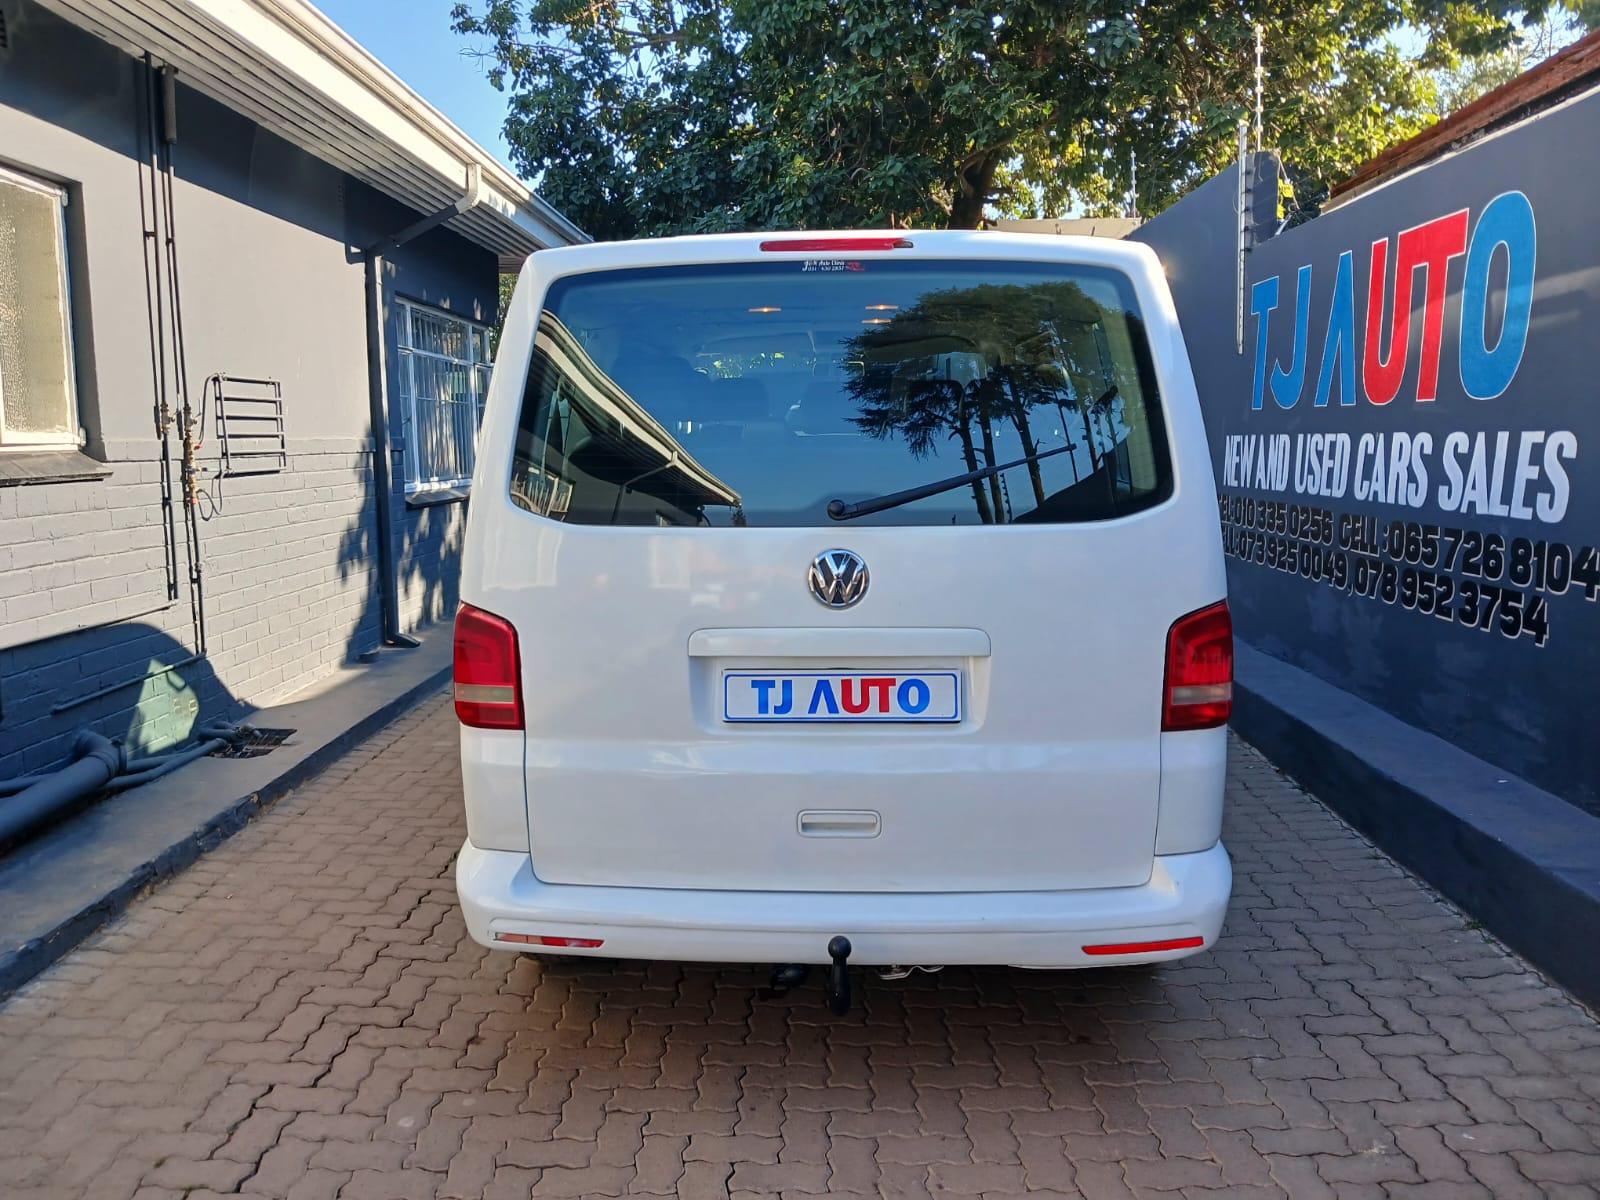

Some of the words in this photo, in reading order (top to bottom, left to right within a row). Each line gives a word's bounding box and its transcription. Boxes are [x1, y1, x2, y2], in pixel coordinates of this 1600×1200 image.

[1250, 263, 1313, 411] TJ
[1313, 189, 1538, 408] AUTO
[1223, 434, 1256, 489] NEW
[1255, 434, 1291, 492] AND
[1294, 432, 1351, 499] USED
[1353, 431, 1434, 509] CARS
[1437, 430, 1578, 524] SALES
[1257, 500, 1288, 536] 335
[1289, 504, 1335, 546] 0256
[1338, 512, 1380, 558] CELL
[1442, 528, 1506, 581] 726
[1508, 537, 1600, 602] 8104
[1266, 537, 1299, 575] 925
[1400, 567, 1456, 623] 952
[1458, 579, 1550, 648] 3754
[751, 678, 793, 715] TJ
[807, 677, 931, 715] AUTO
